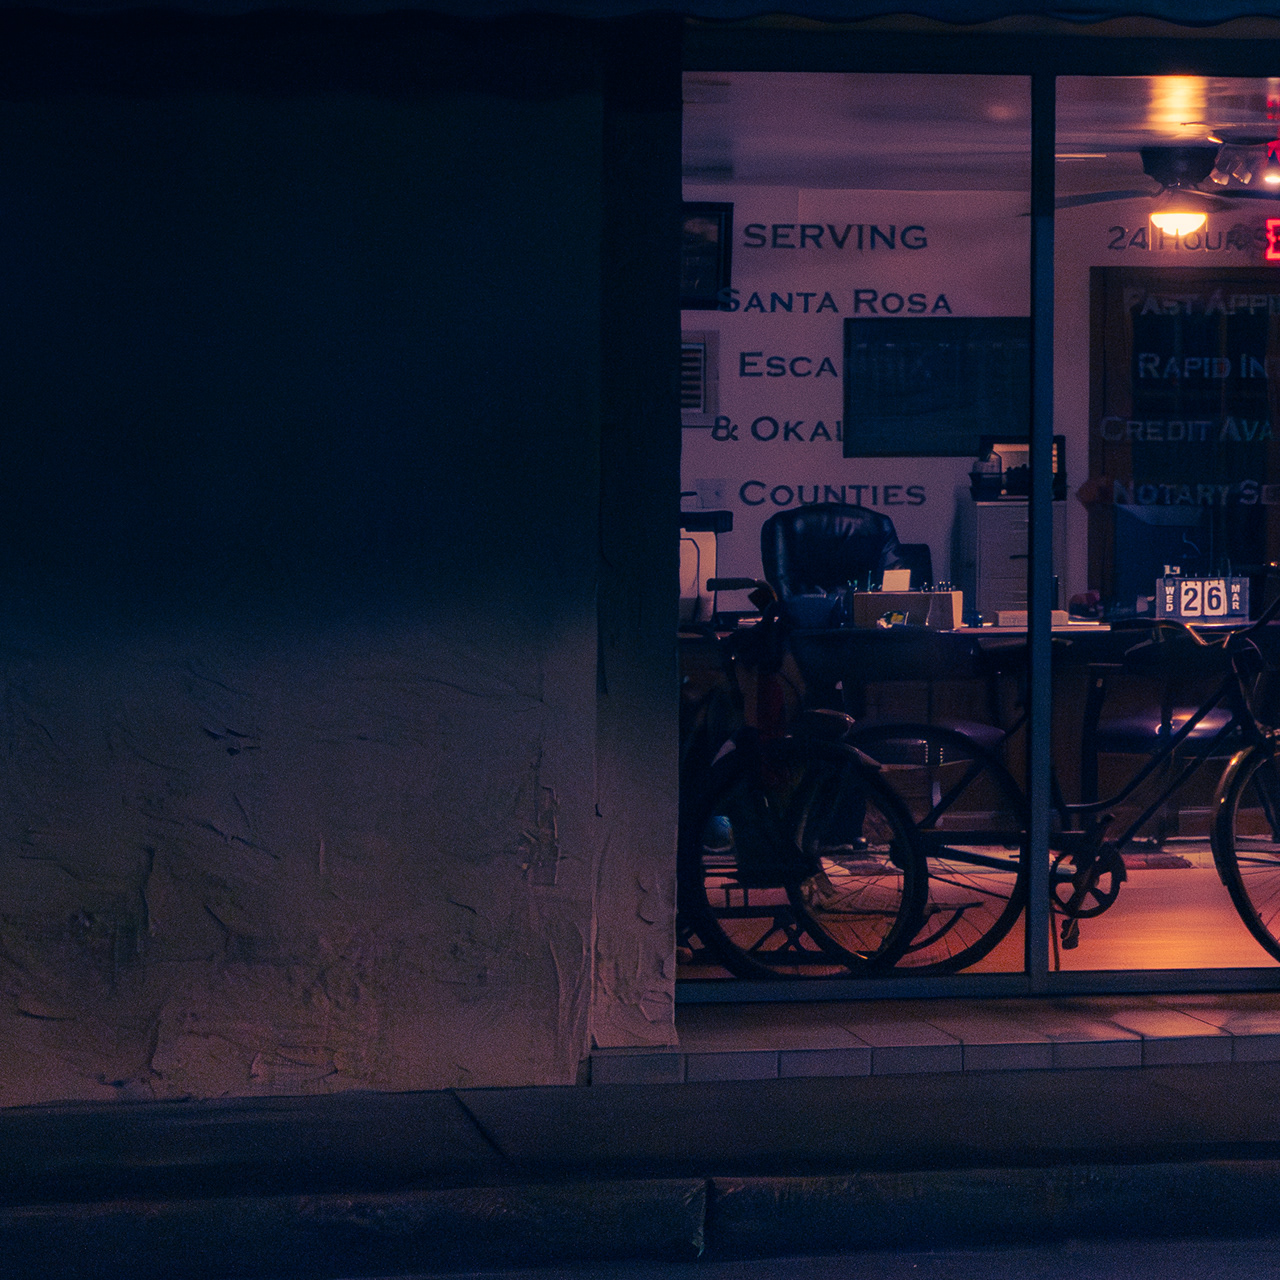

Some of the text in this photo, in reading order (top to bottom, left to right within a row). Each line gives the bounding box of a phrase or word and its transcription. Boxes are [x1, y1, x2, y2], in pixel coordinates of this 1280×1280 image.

[743, 223, 928, 251] SERVING
[1108, 226, 1147, 251] 24
[717, 287, 952, 314] SANTA ROSA
[739, 352, 838, 377] ESCA
[1138, 352, 1231, 379] RAPID
[712, 416, 738, 441] &
[1100, 414, 1211, 442] CREDIT
[739, 481, 926, 506] COUNTIES
[1113, 480, 1231, 506] NOTARY
[1165, 586, 1176, 612] WED
[1184, 586, 1222, 611] 26
[1231, 584, 1241, 610] MAR
